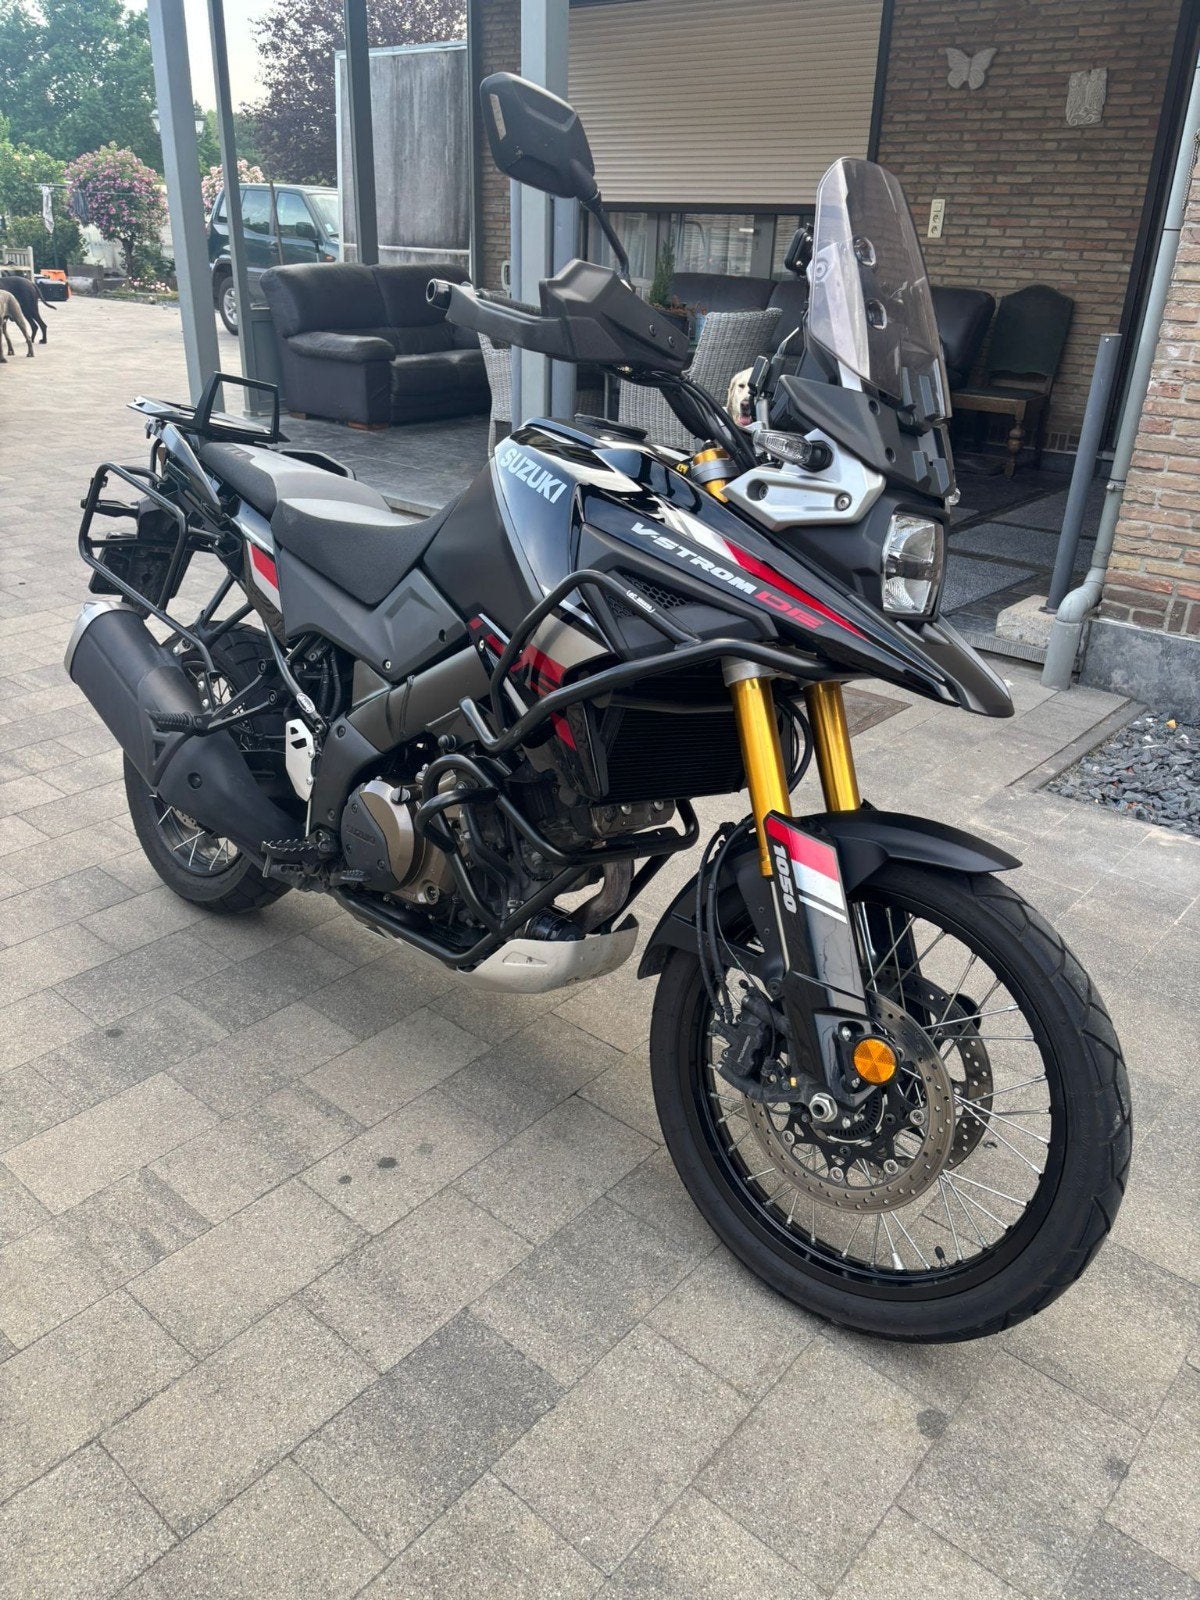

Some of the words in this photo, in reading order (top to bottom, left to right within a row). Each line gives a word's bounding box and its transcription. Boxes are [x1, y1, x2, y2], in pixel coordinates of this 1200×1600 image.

[500, 447, 568, 504] SUZUKI
[630, 522, 758, 595] V-STROM
[754, 590, 825, 630] DE
[773, 844, 798, 914] 1050
